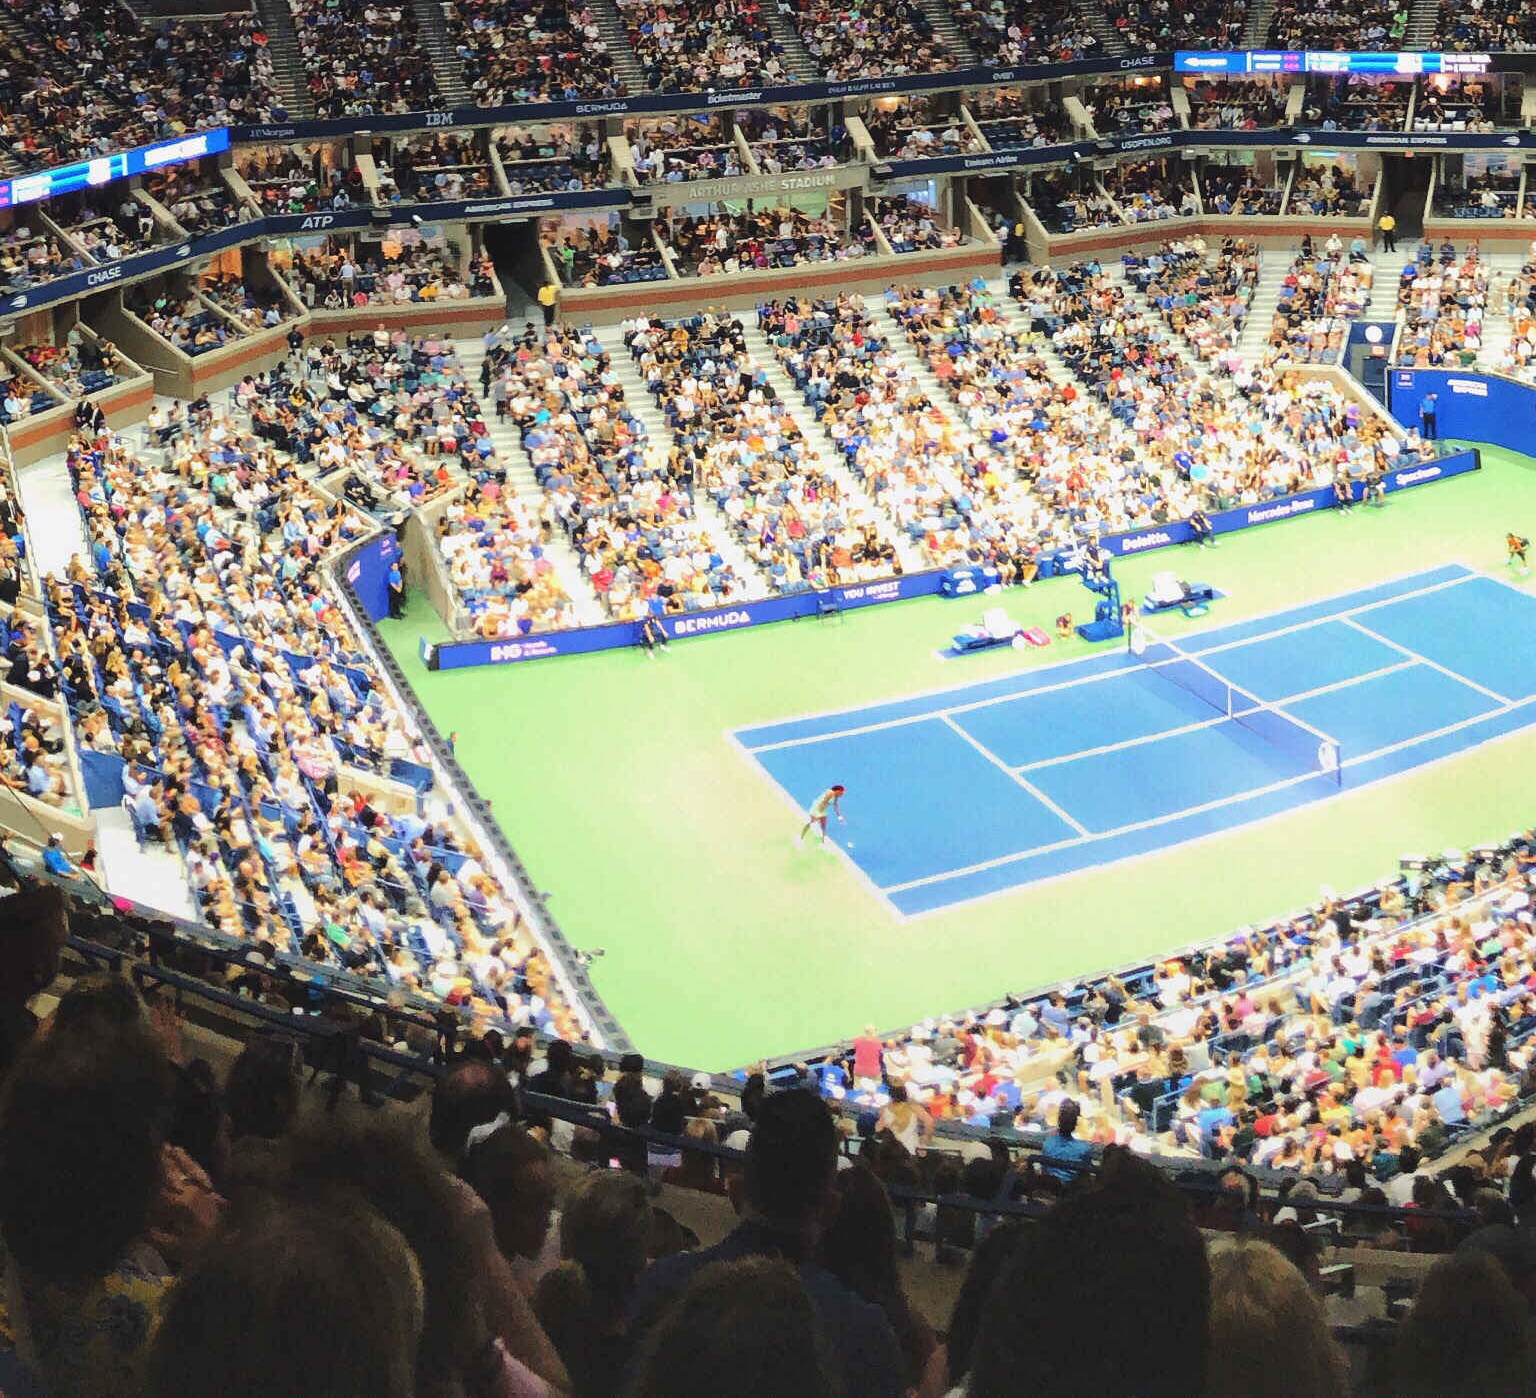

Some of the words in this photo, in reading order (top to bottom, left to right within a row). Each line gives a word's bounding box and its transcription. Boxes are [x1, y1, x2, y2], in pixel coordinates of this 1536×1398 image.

[1120, 56, 1154, 69] CHASE
[707, 90, 763, 104] ticketmaster
[575, 102, 629, 113] BERMUDA
[426, 112, 453, 126] IBM
[1121, 136, 1172, 150] USOPEN.ORG
[1366, 136, 1408, 144] AMERICAN
[1410, 136, 1447, 144] EXPRESS
[688, 183, 739, 200] ARTHUR
[742, 180, 777, 194] ASHE
[781, 175, 835, 190] STADIUM
[464, 200, 512, 213] AMERICAN
[513, 197, 554, 209] EXPRESS
[301, 215, 333, 230] ATP
[87, 266, 122, 285] CHASE
[1248, 499, 1314, 523] Mercedes-Benz
[1122, 532, 1170, 552] Deloitte.
[843, 588, 864, 599] YOU
[866, 581, 900, 595] INVEST
[674, 611, 750, 634] BERMUDA
[491, 644, 522, 661] IHG
